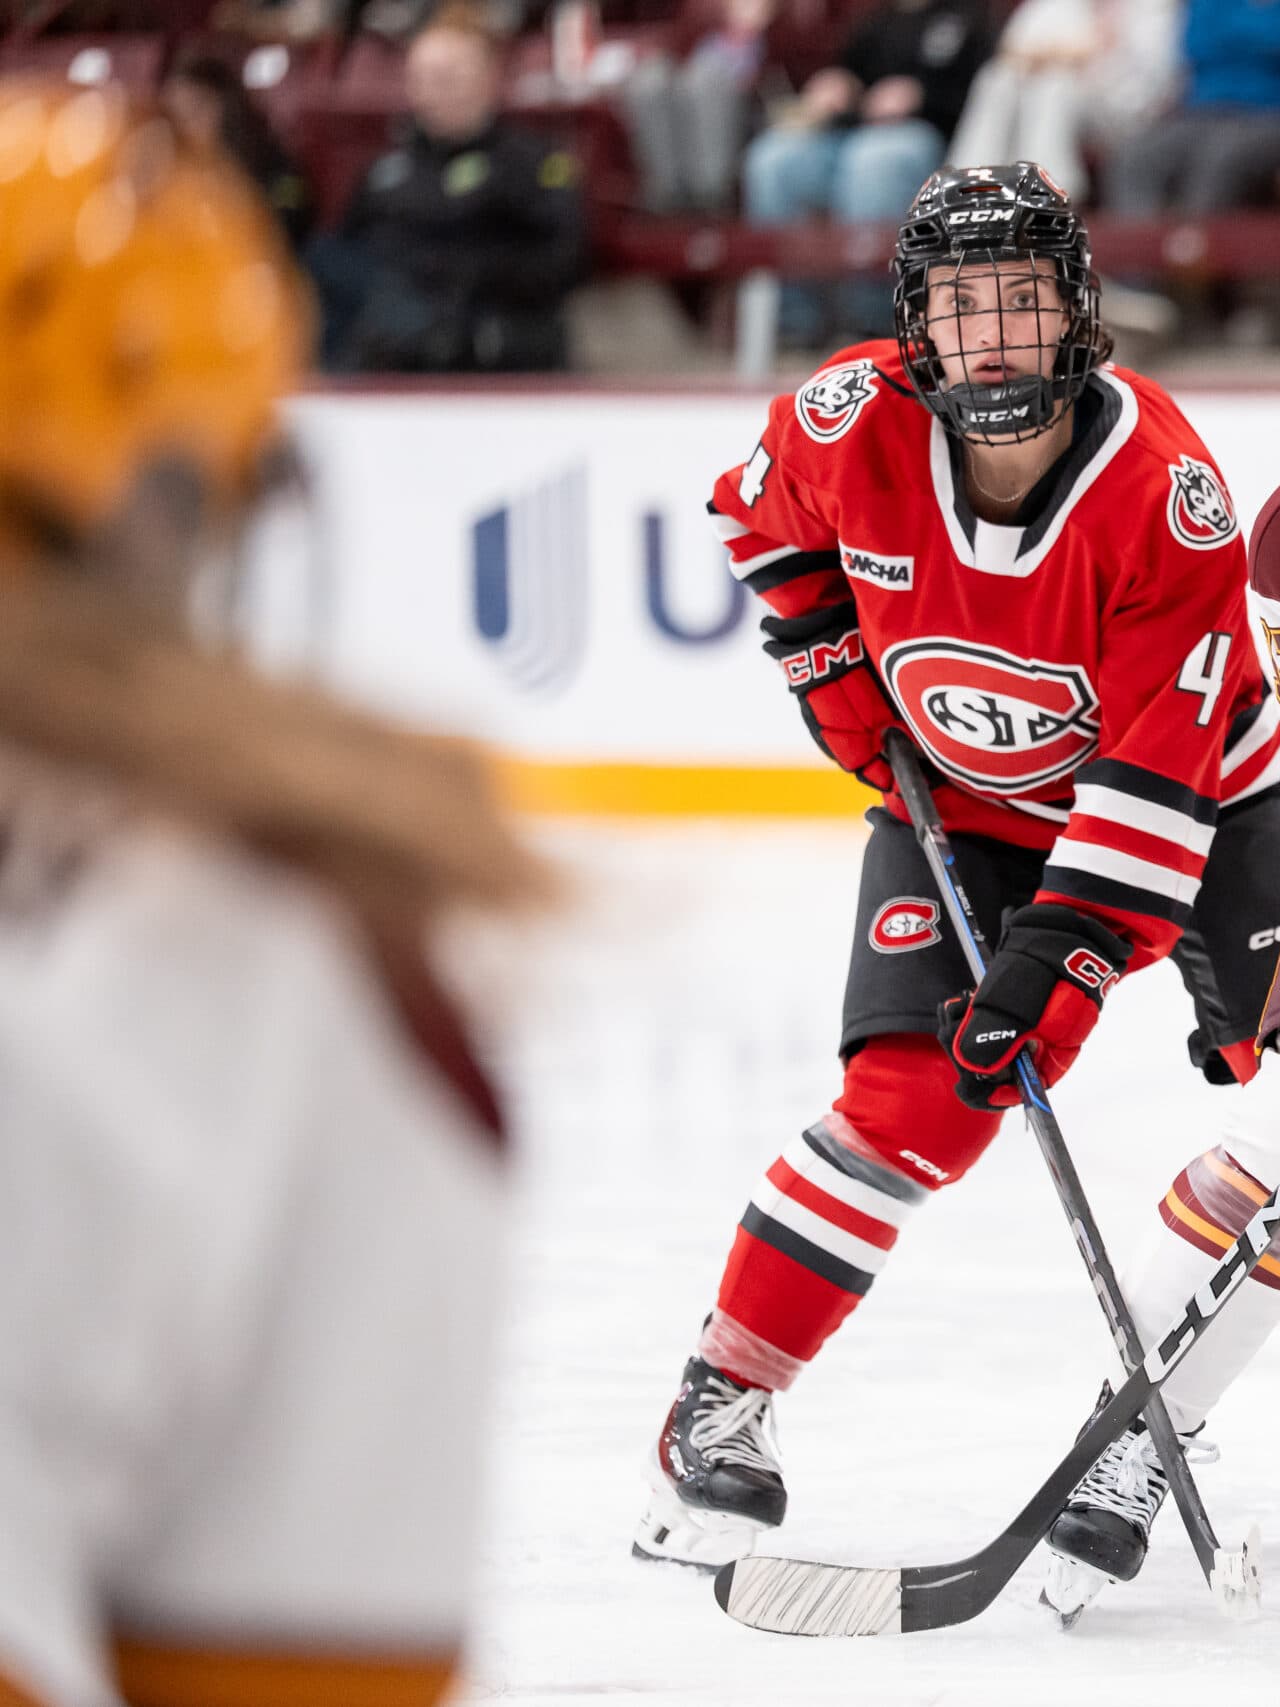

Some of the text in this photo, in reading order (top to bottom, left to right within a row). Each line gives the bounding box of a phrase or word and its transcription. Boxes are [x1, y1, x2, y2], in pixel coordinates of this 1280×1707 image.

[949, 208, 1015, 225] CCM
[969, 404, 1030, 423] CCM
[846, 552, 910, 583] WCHA
[783, 629, 865, 687] CM
[1174, 631, 1233, 728] 4
[975, 1029, 1017, 1043] CCM
[898, 1148, 950, 1181] CCM
